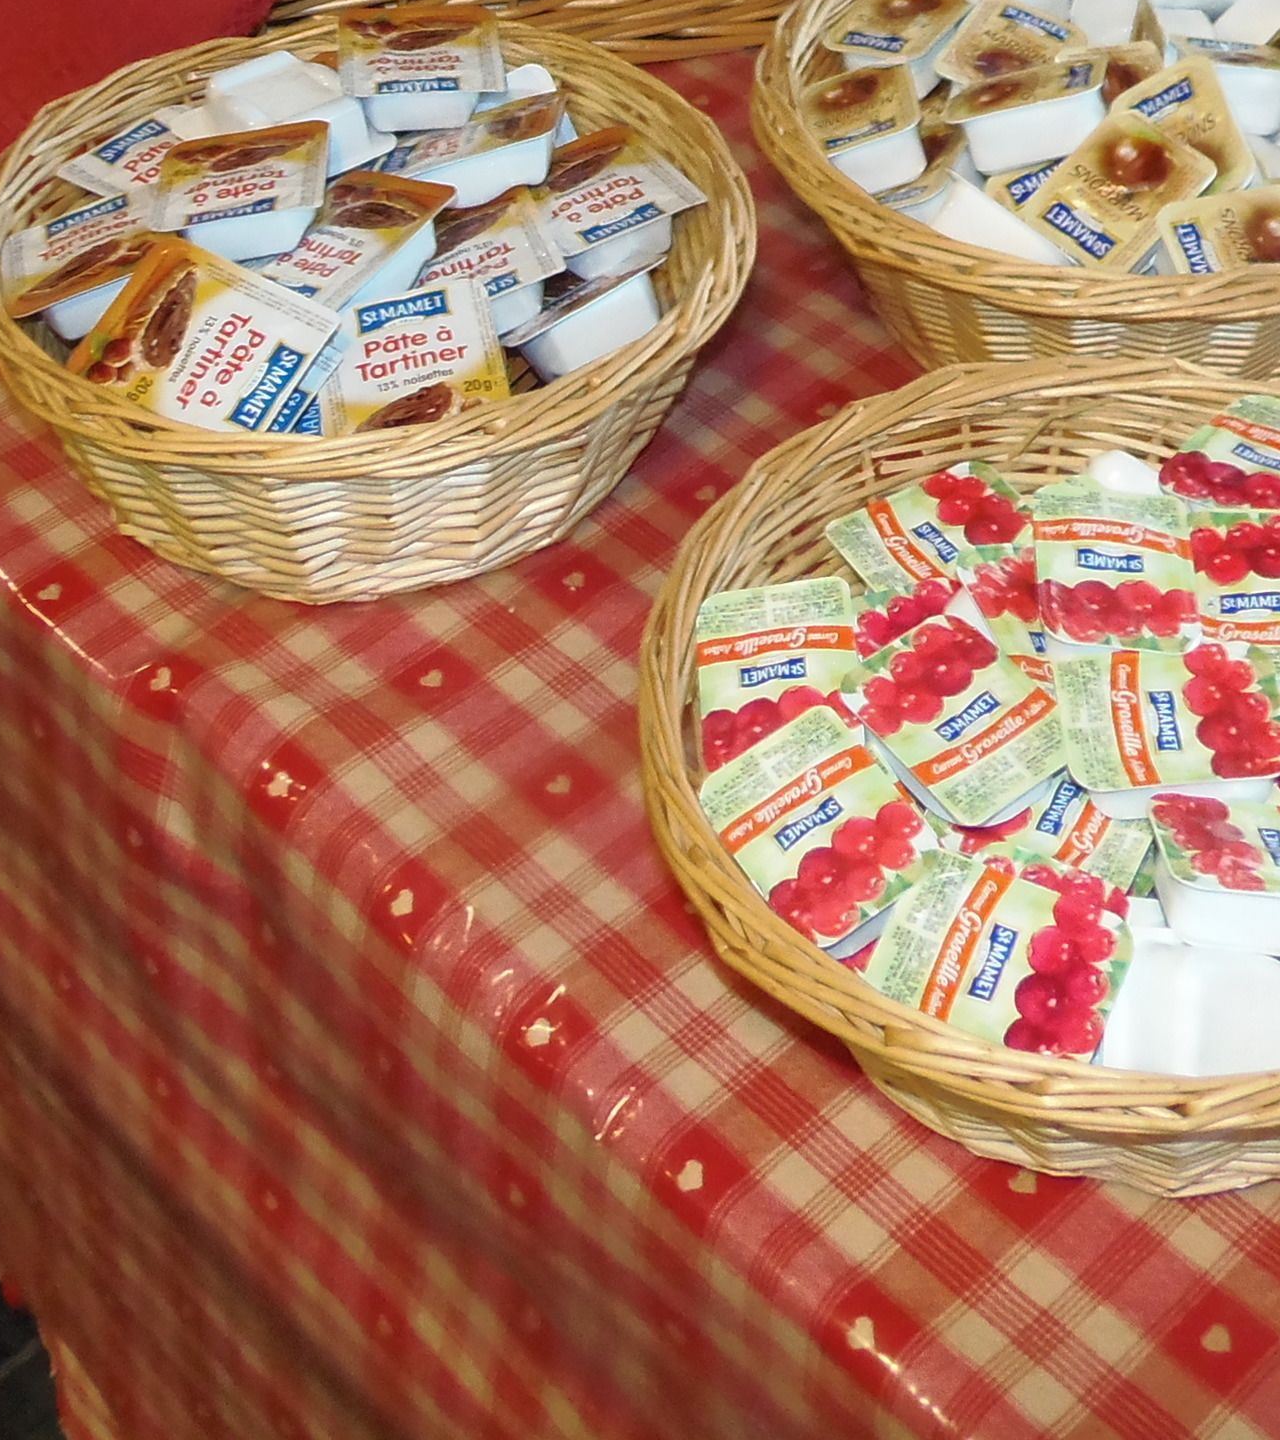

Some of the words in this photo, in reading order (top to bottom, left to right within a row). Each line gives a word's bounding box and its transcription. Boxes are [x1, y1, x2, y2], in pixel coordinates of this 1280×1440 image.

[367, 56, 463, 65] Tartiner
[376, 66, 390, 74] à
[398, 64, 456, 73] Pâte
[1177, 113, 1217, 143] RONS
[123, 141, 173, 172] Pâte
[184, 170, 287, 195] Tartiner
[216, 180, 275, 198] Pâte
[1023, 162, 1064, 192] MAM
[193, 194, 208, 206] à
[552, 176, 643, 218] Tartiner
[588, 188, 645, 213] Pâte
[1070, 164, 1149, 222] MARRONS
[567, 212, 583, 222] à
[1221, 208, 1253, 261] RRONS
[276, 252, 293, 266] à
[297, 237, 363, 265] Tartine
[294, 258, 341, 277] Pâte
[199, 315, 218, 335] 13%
[215, 328, 266, 386] Pâte
[363, 333, 428, 359] Pâte
[436, 325, 453, 342] à
[168, 336, 201, 383] noisettes
[176, 312, 253, 410] Tartiner
[355, 345, 468, 382] Tartiner
[377, 379, 399, 392] 13%
[403, 368, 454, 386] noisettes
[200, 389, 223, 408] à
[1074, 523, 1145, 544] Groseille
[885, 536, 933, 578] Groseille
[734, 628, 807, 656] Groseille
[1112, 690, 1142, 757] Groseille
[961, 715, 1025, 763] Groseille
[755, 768, 823, 823] Groseille
[1071, 808, 1106, 855] Grose
[936, 907, 982, 987] Groseille
